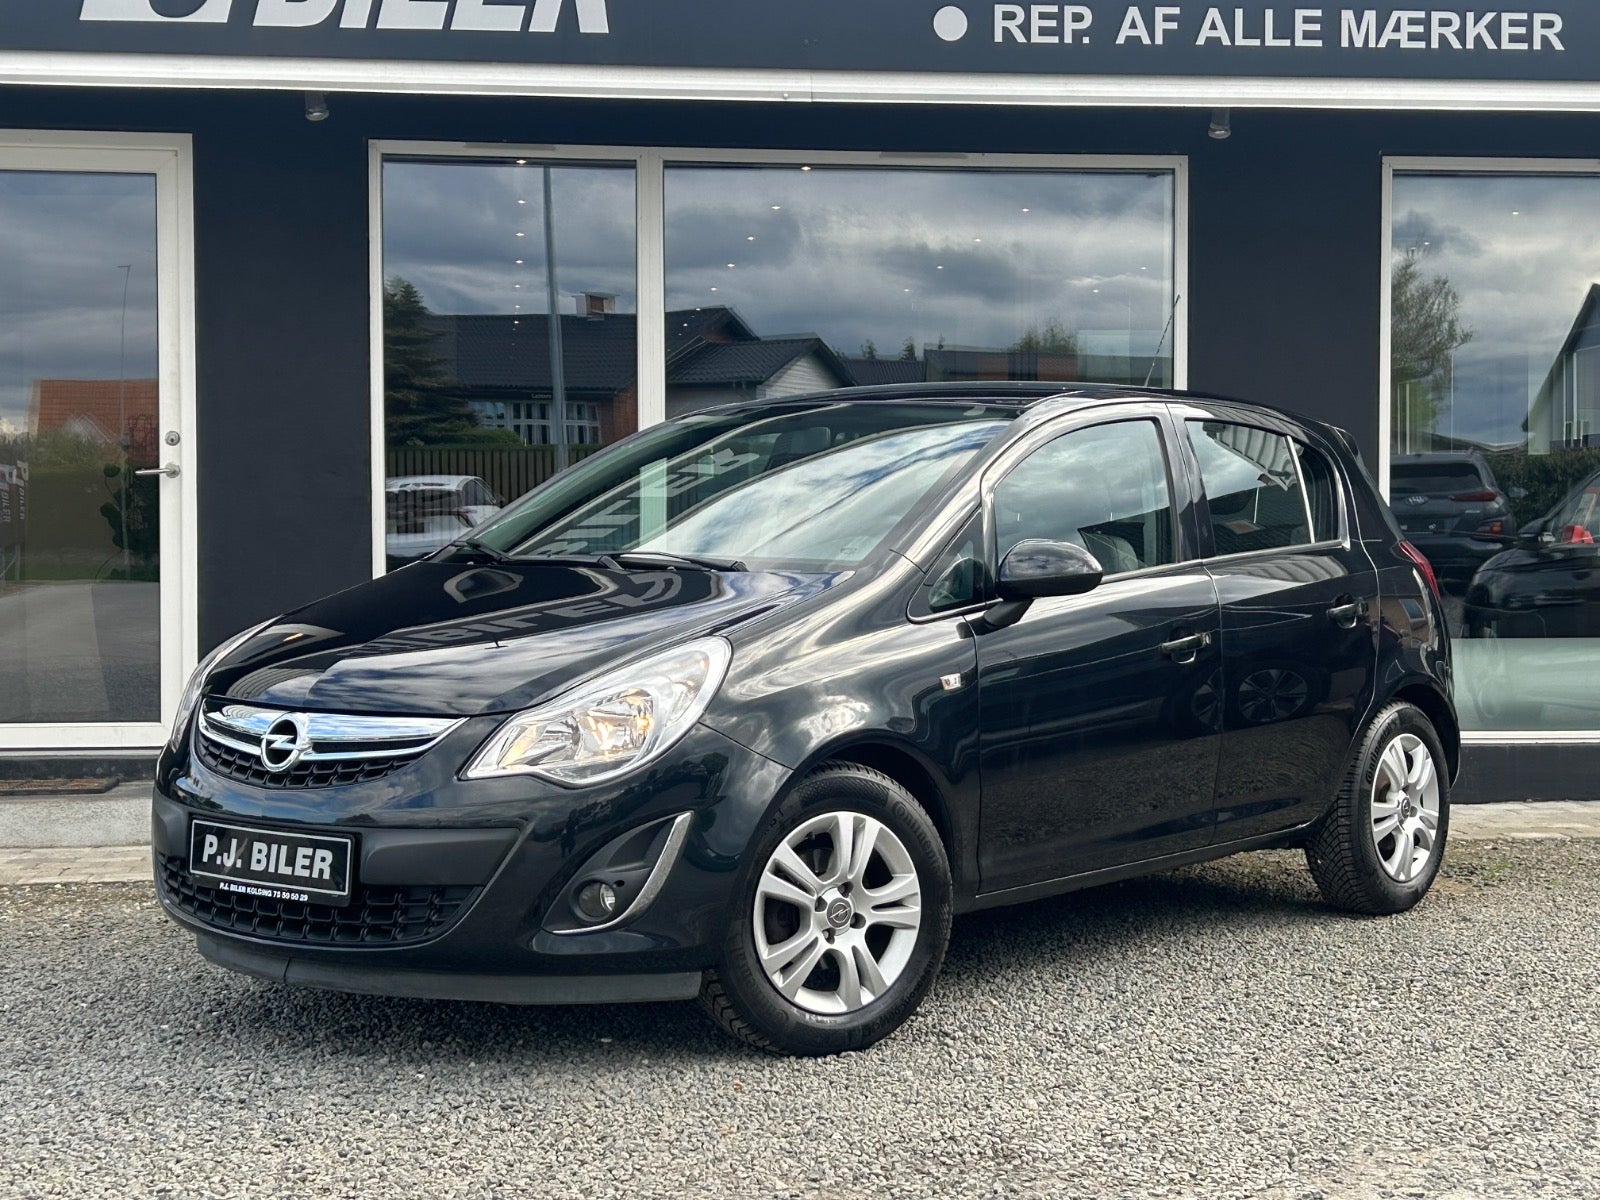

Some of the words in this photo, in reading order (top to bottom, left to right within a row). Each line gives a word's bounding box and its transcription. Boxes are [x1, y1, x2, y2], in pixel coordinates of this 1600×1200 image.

[995, 5, 1092, 43] REP.
[1116, 7, 1180, 44] AF
[1196, 8, 1322, 46] ALLE
[1341, 10, 1564, 50] MÆRKER
[202, 833, 243, 868] P.J.
[250, 841, 334, 880] BILER
